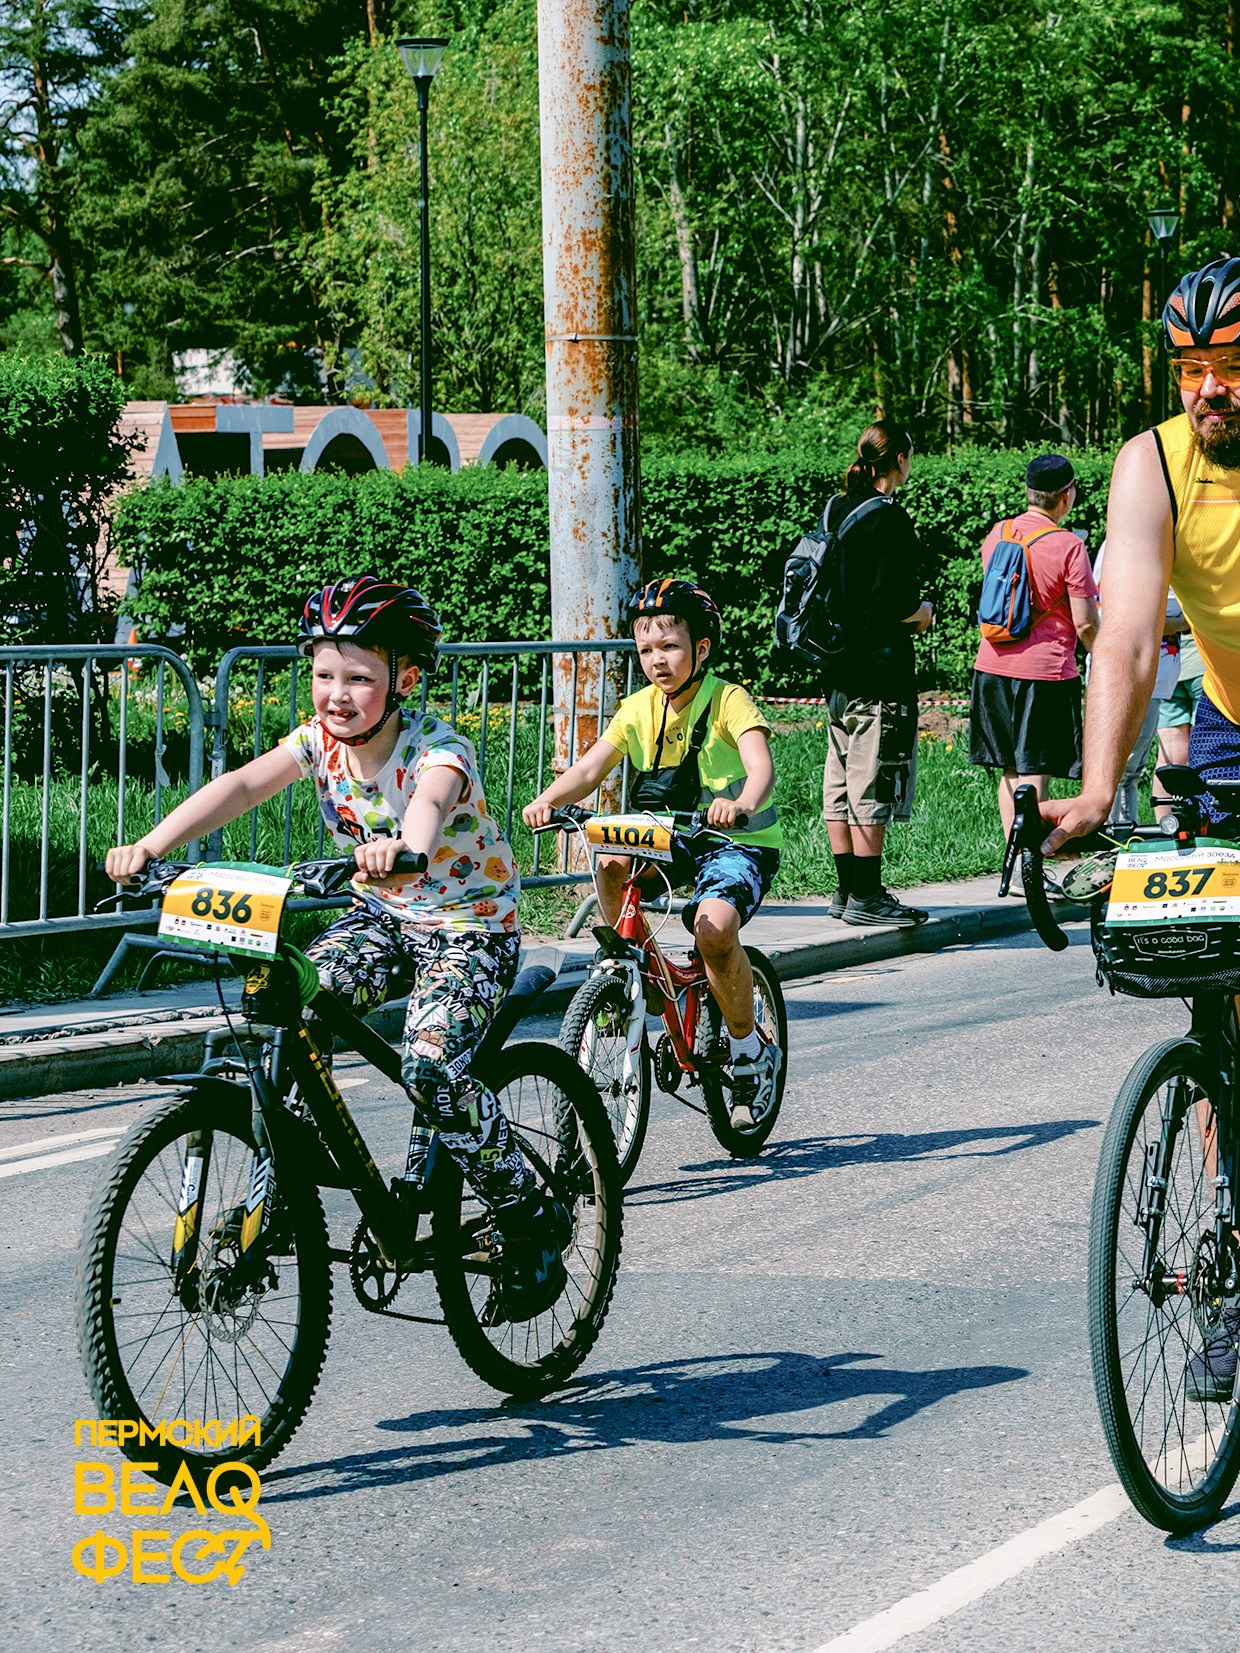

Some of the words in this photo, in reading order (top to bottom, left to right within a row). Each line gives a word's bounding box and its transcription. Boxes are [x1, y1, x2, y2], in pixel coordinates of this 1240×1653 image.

[601, 826, 655, 848] 1104
[1143, 867, 1216, 900] 837
[191, 886, 253, 924] 836
